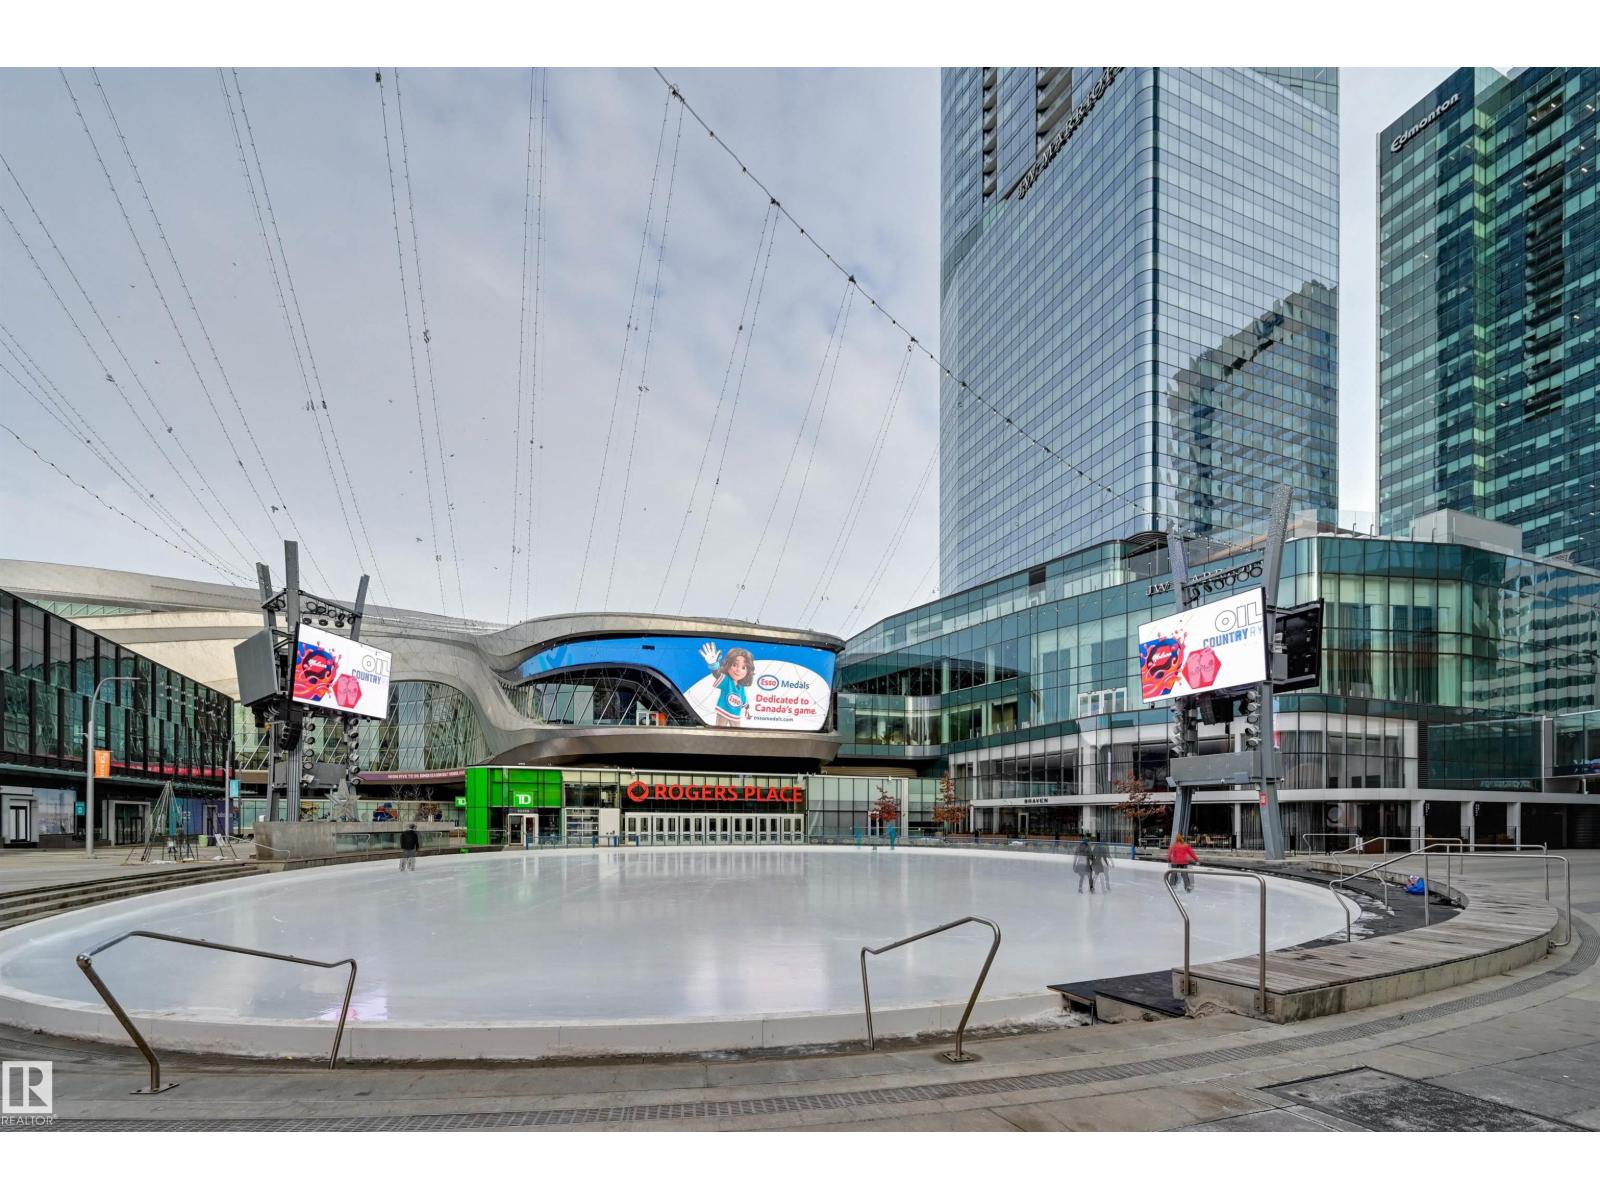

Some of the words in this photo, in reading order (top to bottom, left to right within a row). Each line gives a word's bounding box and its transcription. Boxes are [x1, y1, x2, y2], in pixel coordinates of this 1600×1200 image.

[1390, 93, 1460, 152] Edmonton
[1215, 602, 1262, 632] OIL
[1202, 628, 1248, 649] COUNTRY
[362, 654, 390, 677] OIL
[352, 668, 382, 685] COUNTRY
[760, 678, 777, 686] Esso
[781, 680, 810, 689] Medals
[756, 694, 798, 704] Dedicated
[800, 697, 809, 705] to
[755, 704, 792, 714] Canada's
[516, 794, 531, 804] TD
[654, 784, 738, 801] ROGERS
[744, 786, 803, 802] PLACE
